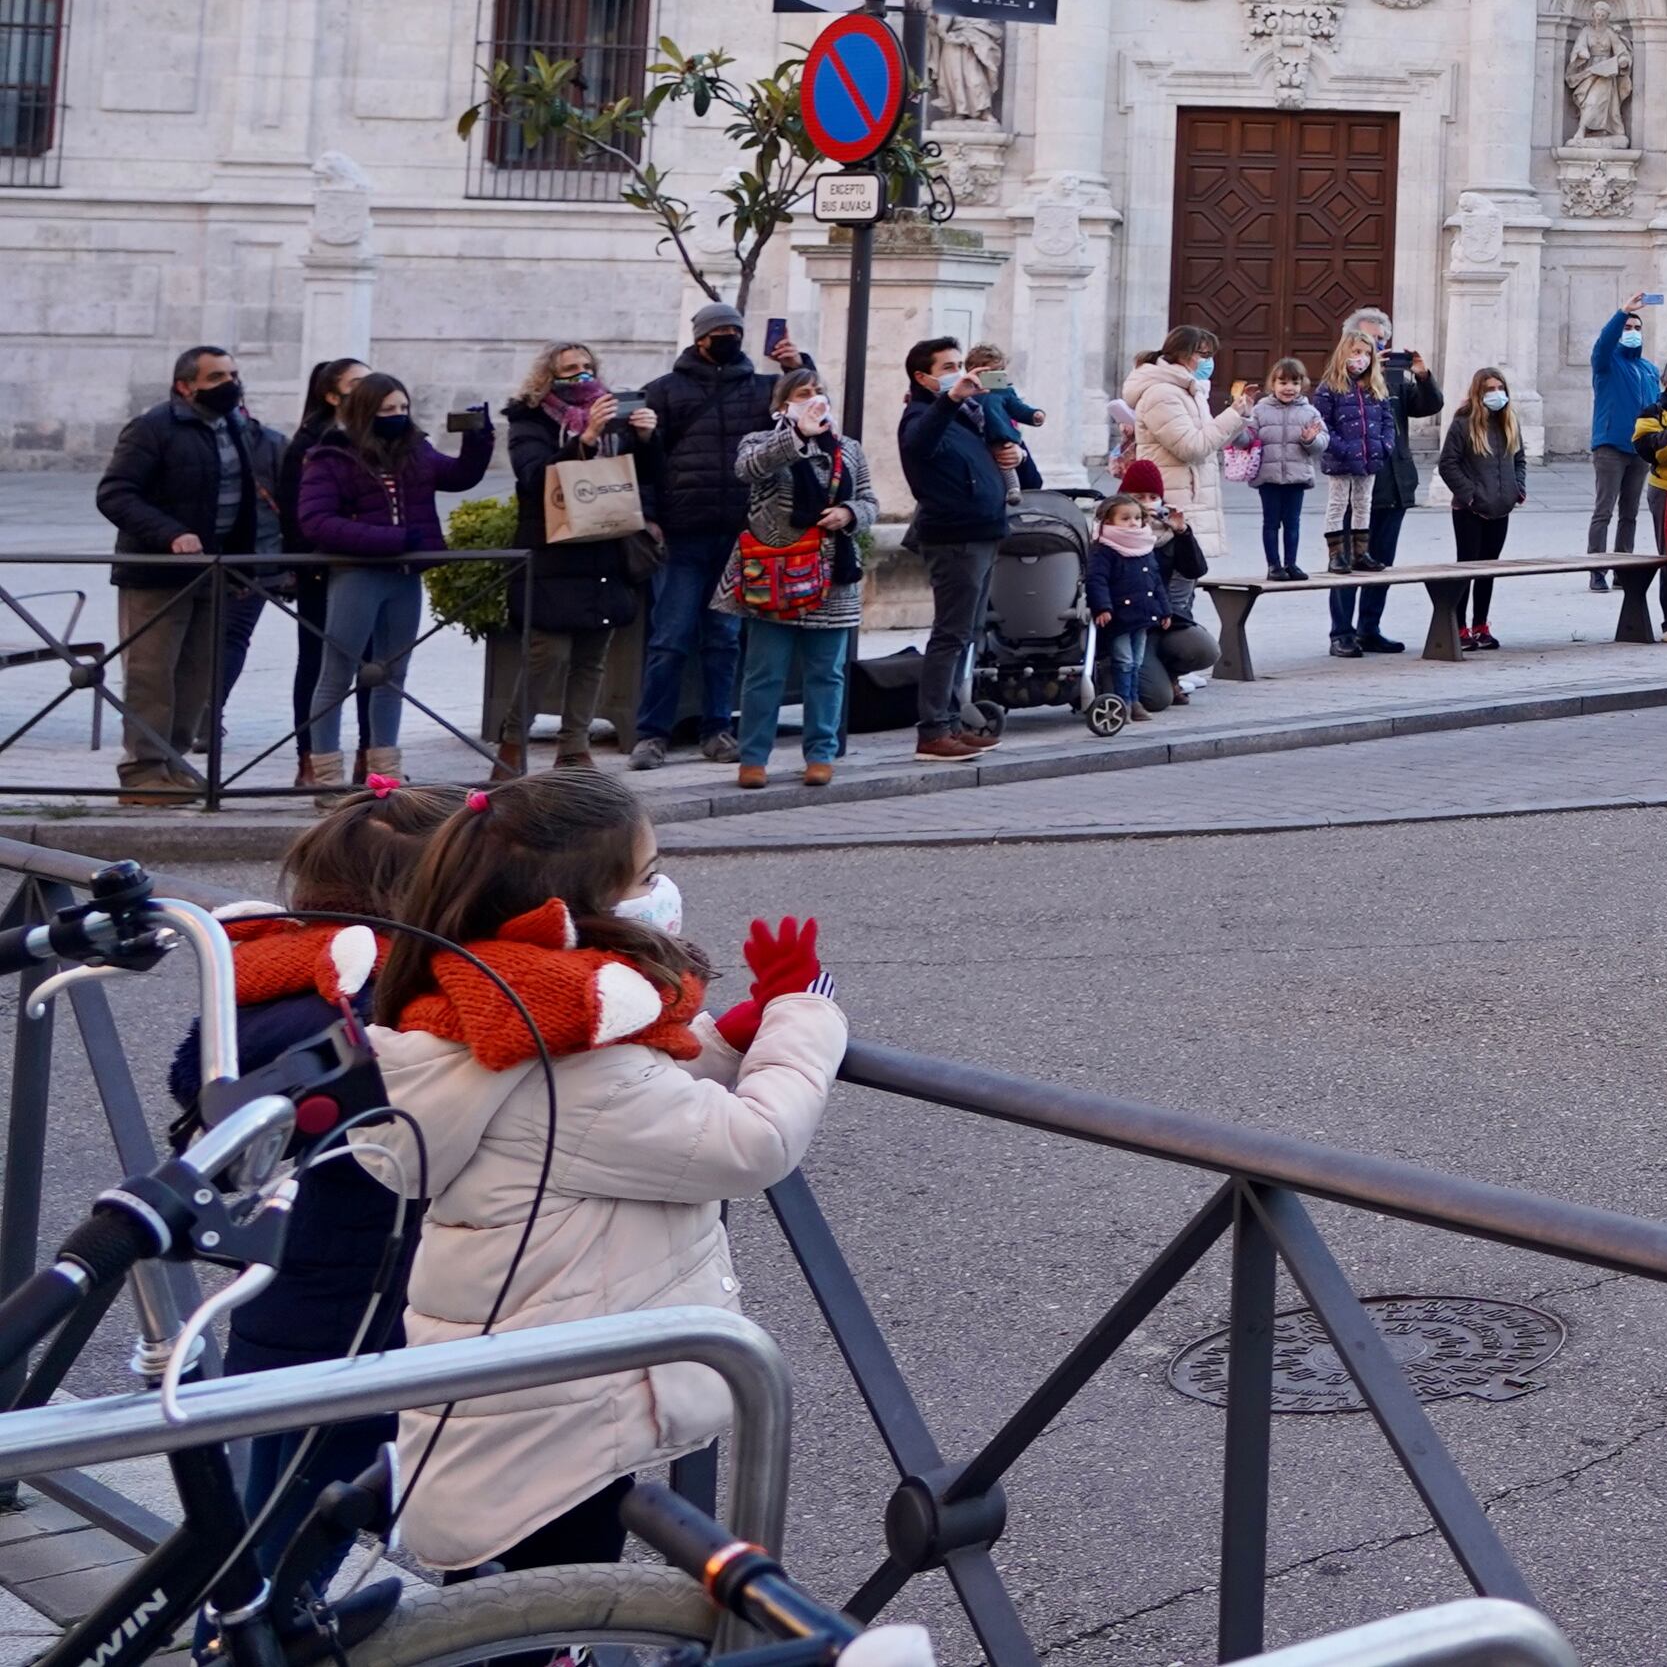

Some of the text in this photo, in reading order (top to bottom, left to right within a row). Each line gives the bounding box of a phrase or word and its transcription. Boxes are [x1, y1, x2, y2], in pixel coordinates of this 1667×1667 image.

[830, 183, 865, 195] EXCEPTO
[821, 201, 872, 212] BUS AUVASA
